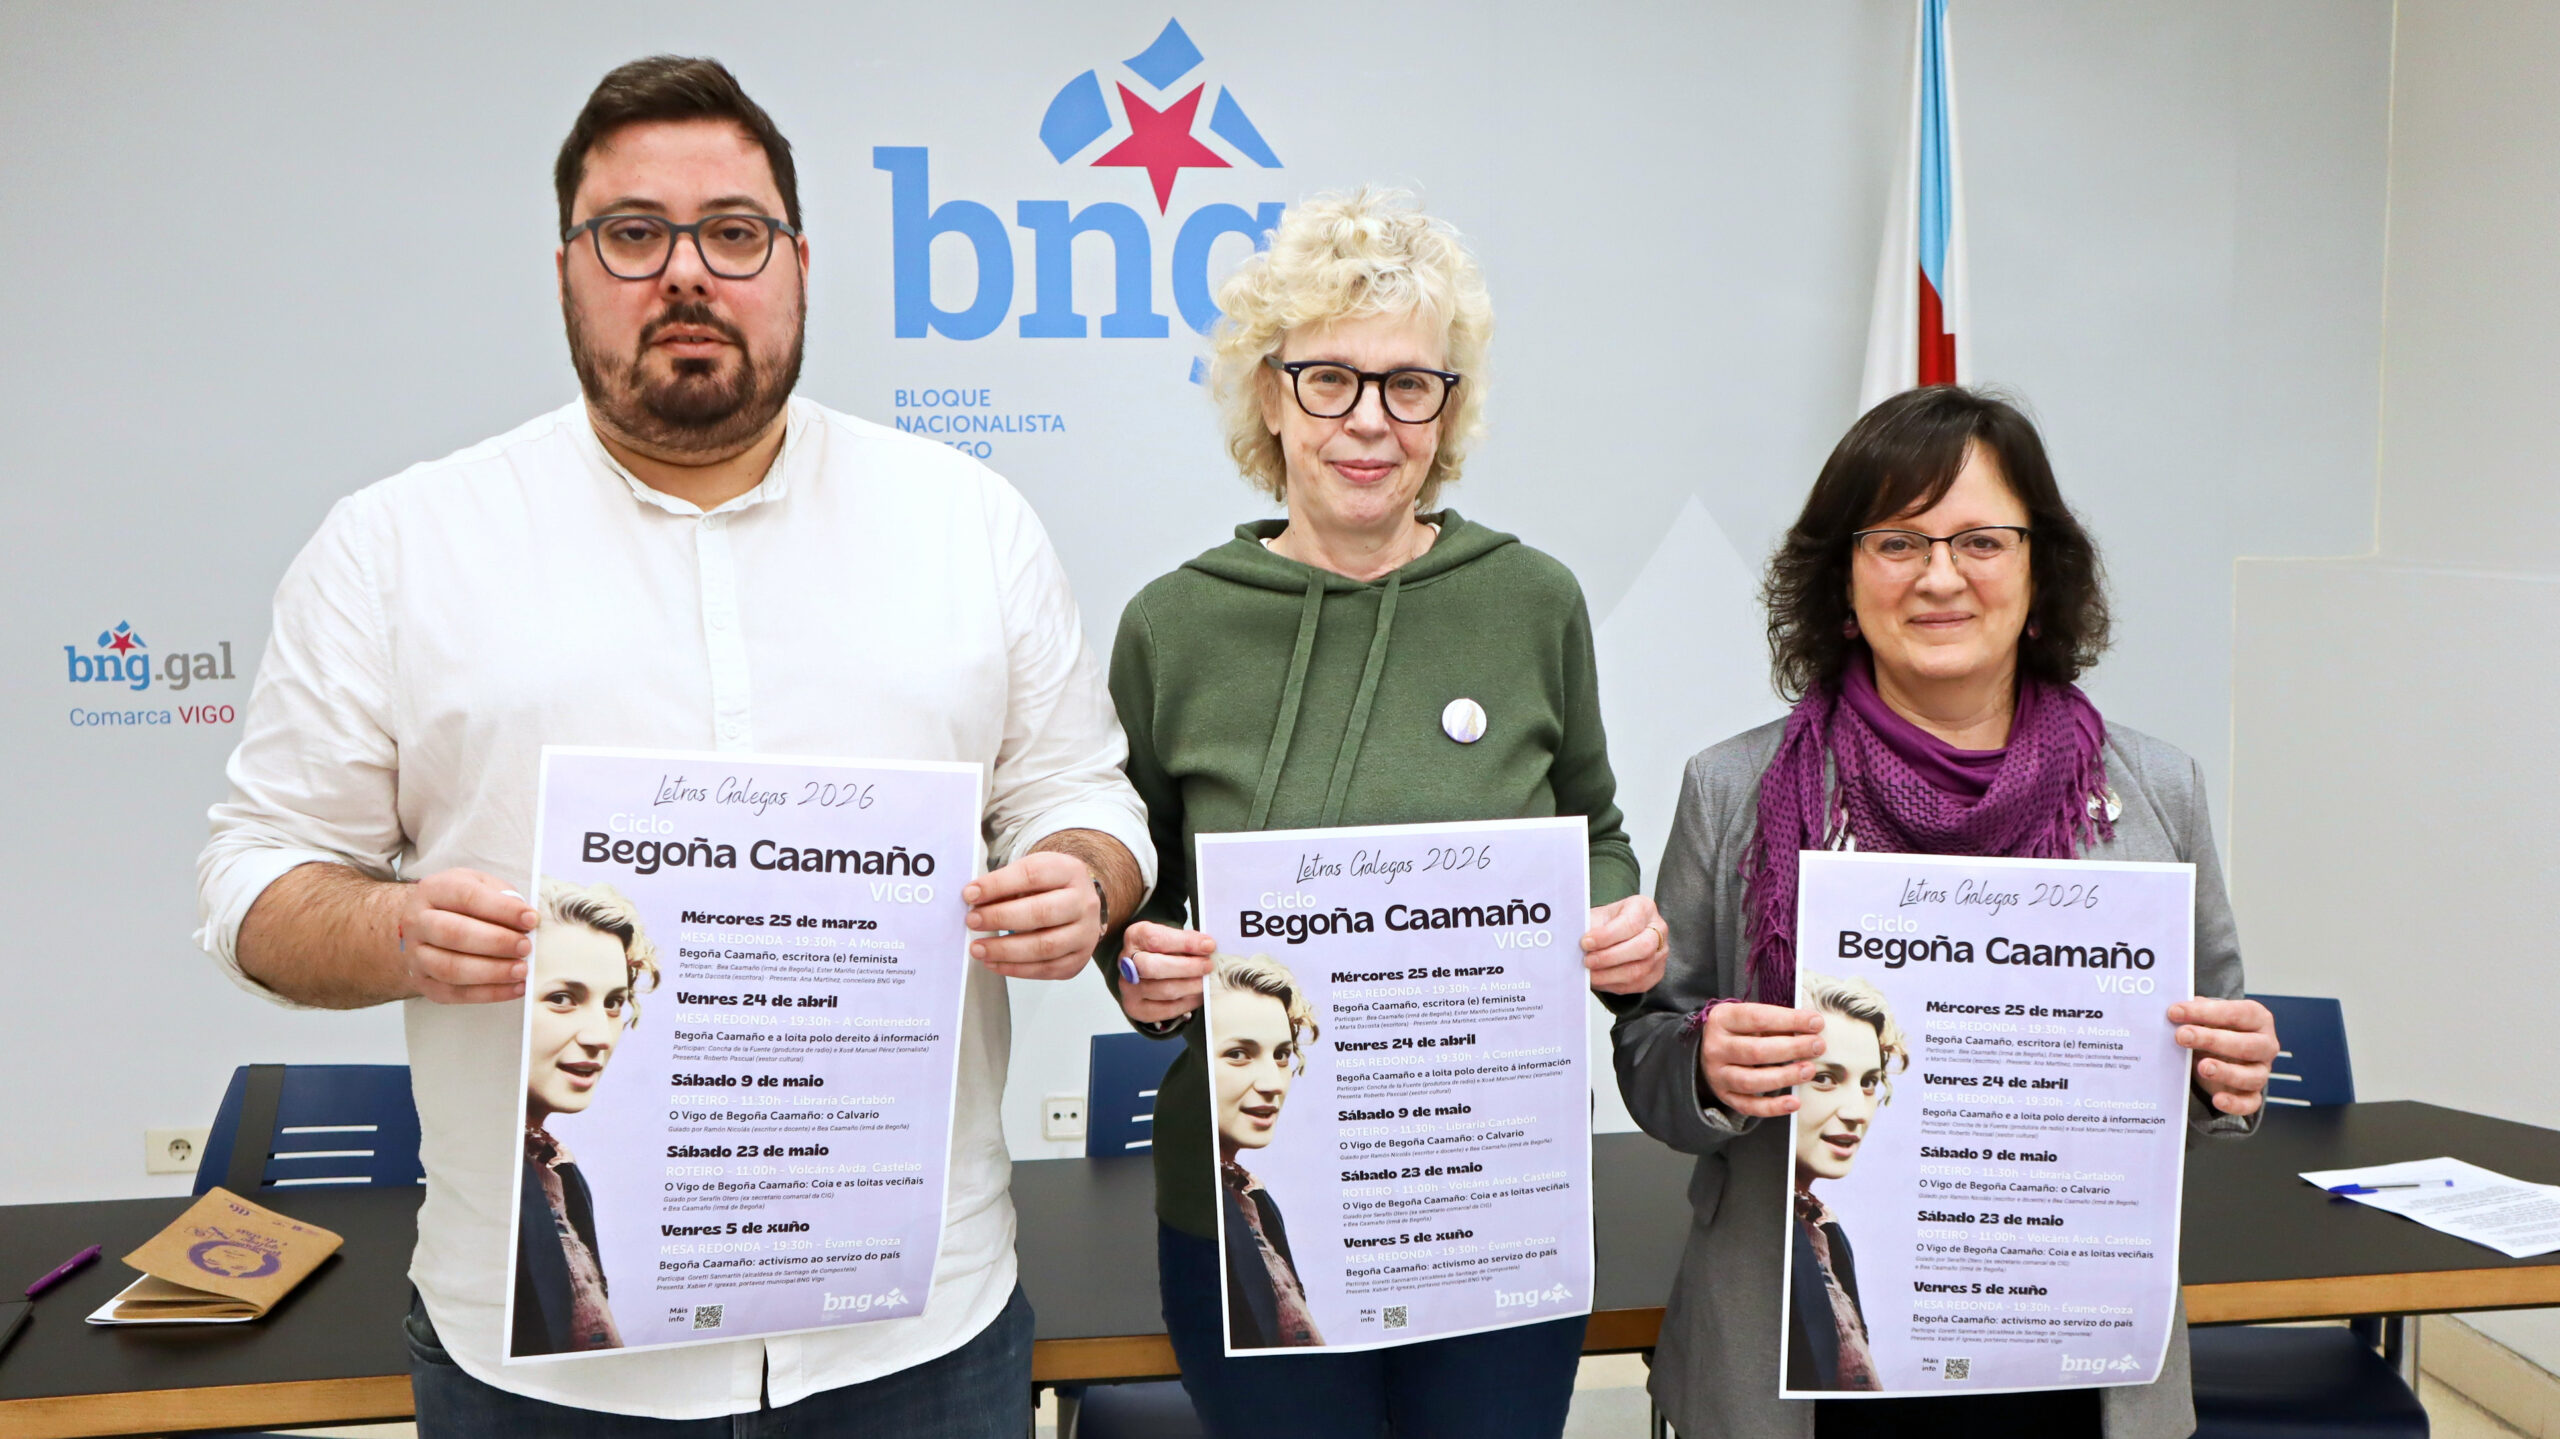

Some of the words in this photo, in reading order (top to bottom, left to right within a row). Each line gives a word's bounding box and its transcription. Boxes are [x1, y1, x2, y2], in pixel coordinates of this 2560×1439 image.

[894, 389, 991, 407] BLOQUE
[895, 414, 1066, 433] NACIONALISTA
[63, 641, 236, 691] bng.gal
[69, 707, 172, 727] Comarca
[178, 704, 235, 724] VIGO
[653, 774, 708, 807] Letras
[715, 775, 789, 817] Galegas
[796, 781, 875, 810] 2026
[608, 812, 674, 835] Ciclo
[582, 831, 737, 875] Begoña
[749, 839, 935, 877] Caamaño
[1295, 852, 1342, 885] Letras
[1349, 849, 1414, 885] Galegas
[1421, 844, 1491, 872] 2026
[869, 880, 934, 904] VIGO
[1259, 890, 1317, 910] Ciclo
[1898, 877, 1947, 908] Letras
[1954, 878, 2020, 917] Galegas
[2027, 882, 2099, 909] 2026
[680, 910, 765, 926] Mércores
[768, 914, 792, 927] 25
[795, 914, 818, 928] de
[821, 918, 878, 930] marzo
[1240, 907, 1375, 945] Begoña
[1384, 898, 1551, 932] Caamaño
[1860, 912, 1919, 933] Ciclo
[680, 931, 715, 943] MESA
[718, 932, 784, 946] REDONDA
[794, 935, 837, 948] 19:30h
[847, 937, 857, 948] A
[859, 938, 905, 950] Morada
[1493, 928, 1552, 950] VIGO
[679, 947, 721, 960] Begoña
[723, 949, 779, 961] Caamaño,
[781, 952, 830, 962] escritora
[832, 952, 847, 964] (e)
[848, 953, 898, 964] feminista
[1838, 930, 1974, 969] Begoña
[1985, 936, 2156, 970] Caamaño
[1331, 971, 1404, 983] Mércores
[1407, 967, 1428, 980] 25
[1431, 966, 1451, 978] de
[1454, 965, 1504, 977] marzo
[2094, 974, 2155, 995] VIGO
[676, 991, 738, 1006] Venres
[742, 993, 767, 1006] 24
[771, 994, 793, 1007] de
[796, 994, 838, 1008] abril
[1926, 1000, 2001, 1015] Mércores
[2004, 1004, 2025, 1016] 25
[2028, 1004, 2049, 1017] de
[2052, 1008, 2104, 1019] marzo
[675, 1012, 710, 1024] MESA
[713, 1013, 778, 1026] REDONDA
[789, 1015, 831, 1027] 19:30h
[842, 1016, 852, 1026] A
[854, 1016, 931, 1027] Contenedora
[674, 1030, 714, 1042] Begoña
[715, 1031, 766, 1042] Caamaño
[767, 1034, 774, 1042] e
[775, 1034, 782, 1042] a
[784, 1032, 807, 1042] loita
[809, 1033, 833, 1044] polo
[834, 1033, 871, 1043] dereito
[872, 1033, 879, 1043] á
[880, 1032, 940, 1043] información
[1334, 1041, 1389, 1052] Venres
[1391, 1037, 1414, 1049] 24
[1416, 1036, 1436, 1048] de
[1439, 1033, 1476, 1047] abril
[671, 1073, 737, 1087] Sábado
[740, 1074, 753, 1087] 9
[757, 1074, 779, 1087] de
[782, 1074, 824, 1087] maio
[1923, 1073, 1978, 1087] Venres
[1982, 1075, 2004, 1087] 24
[2007, 1076, 2027, 1088] de
[2031, 1077, 2069, 1090] abril
[669, 1110, 679, 1120] O
[681, 1110, 707, 1123] Vigo
[709, 1111, 723, 1121] de
[726, 1110, 768, 1123] Begoña
[770, 1110, 824, 1121] Caamaño:
[826, 1112, 834, 1120] o
[836, 1109, 880, 1120] Calvario
[1337, 1108, 1395, 1122] Sábado
[1398, 1107, 1409, 1119] 9
[1412, 1106, 1432, 1118] de
[1434, 1102, 1472, 1116] maio
[666, 1144, 732, 1158] Sábado
[736, 1145, 759, 1158] 23
[762, 1144, 784, 1157] de
[788, 1143, 829, 1157] maio
[1920, 1146, 1979, 1160] Sábado
[1982, 1148, 1993, 1160] 9
[1996, 1149, 2016, 1161] de
[2019, 1150, 2058, 1163] maio
[1340, 1168, 1398, 1182] Sábado
[1401, 1166, 1421, 1179] 23
[1424, 1165, 1443, 1177] de
[1446, 1161, 1483, 1175] maio
[664, 1182, 674, 1192] O
[675, 1182, 700, 1194] Vigo
[701, 1181, 715, 1191] de
[717, 1181, 756, 1193] Begoña
[758, 1180, 808, 1190] Caamaño:
[811, 1179, 834, 1189] Coia
[835, 1180, 842, 1188] e
[843, 1180, 855, 1188] as
[856, 1178, 884, 1187] loitas
[885, 1176, 924, 1186] veciñais
[1917, 1210, 1976, 1224] Sábado
[1979, 1212, 2000, 1225] 23
[2003, 1213, 2023, 1225] de
[2026, 1214, 2064, 1227] maio
[661, 1224, 722, 1237] Venres
[725, 1222, 737, 1235] 5
[741, 1221, 763, 1234] de
[766, 1220, 810, 1234] xuño
[1343, 1236, 1397, 1248] Venres
[1399, 1233, 1410, 1245] 5
[1413, 1232, 1432, 1243] de
[1435, 1228, 1474, 1241] xuño
[659, 1260, 700, 1272] Begoña
[702, 1257, 756, 1269] Caamaño:
[758, 1255, 809, 1266] activismo
[810, 1256, 824, 1264] ao
[825, 1253, 863, 1263] servizo
[864, 1251, 878, 1261] do
[880, 1250, 901, 1262] país
[1913, 1281, 1968, 1294] Venres
[1970, 1282, 1982, 1294] 5
[1985, 1283, 2004, 1295] de
[2007, 1284, 2048, 1296] xuño
[822, 1291, 873, 1313] bng
[1493, 1289, 1539, 1308] bng
[668, 1315, 685, 1323] info
[2060, 1353, 2110, 1375] bng
